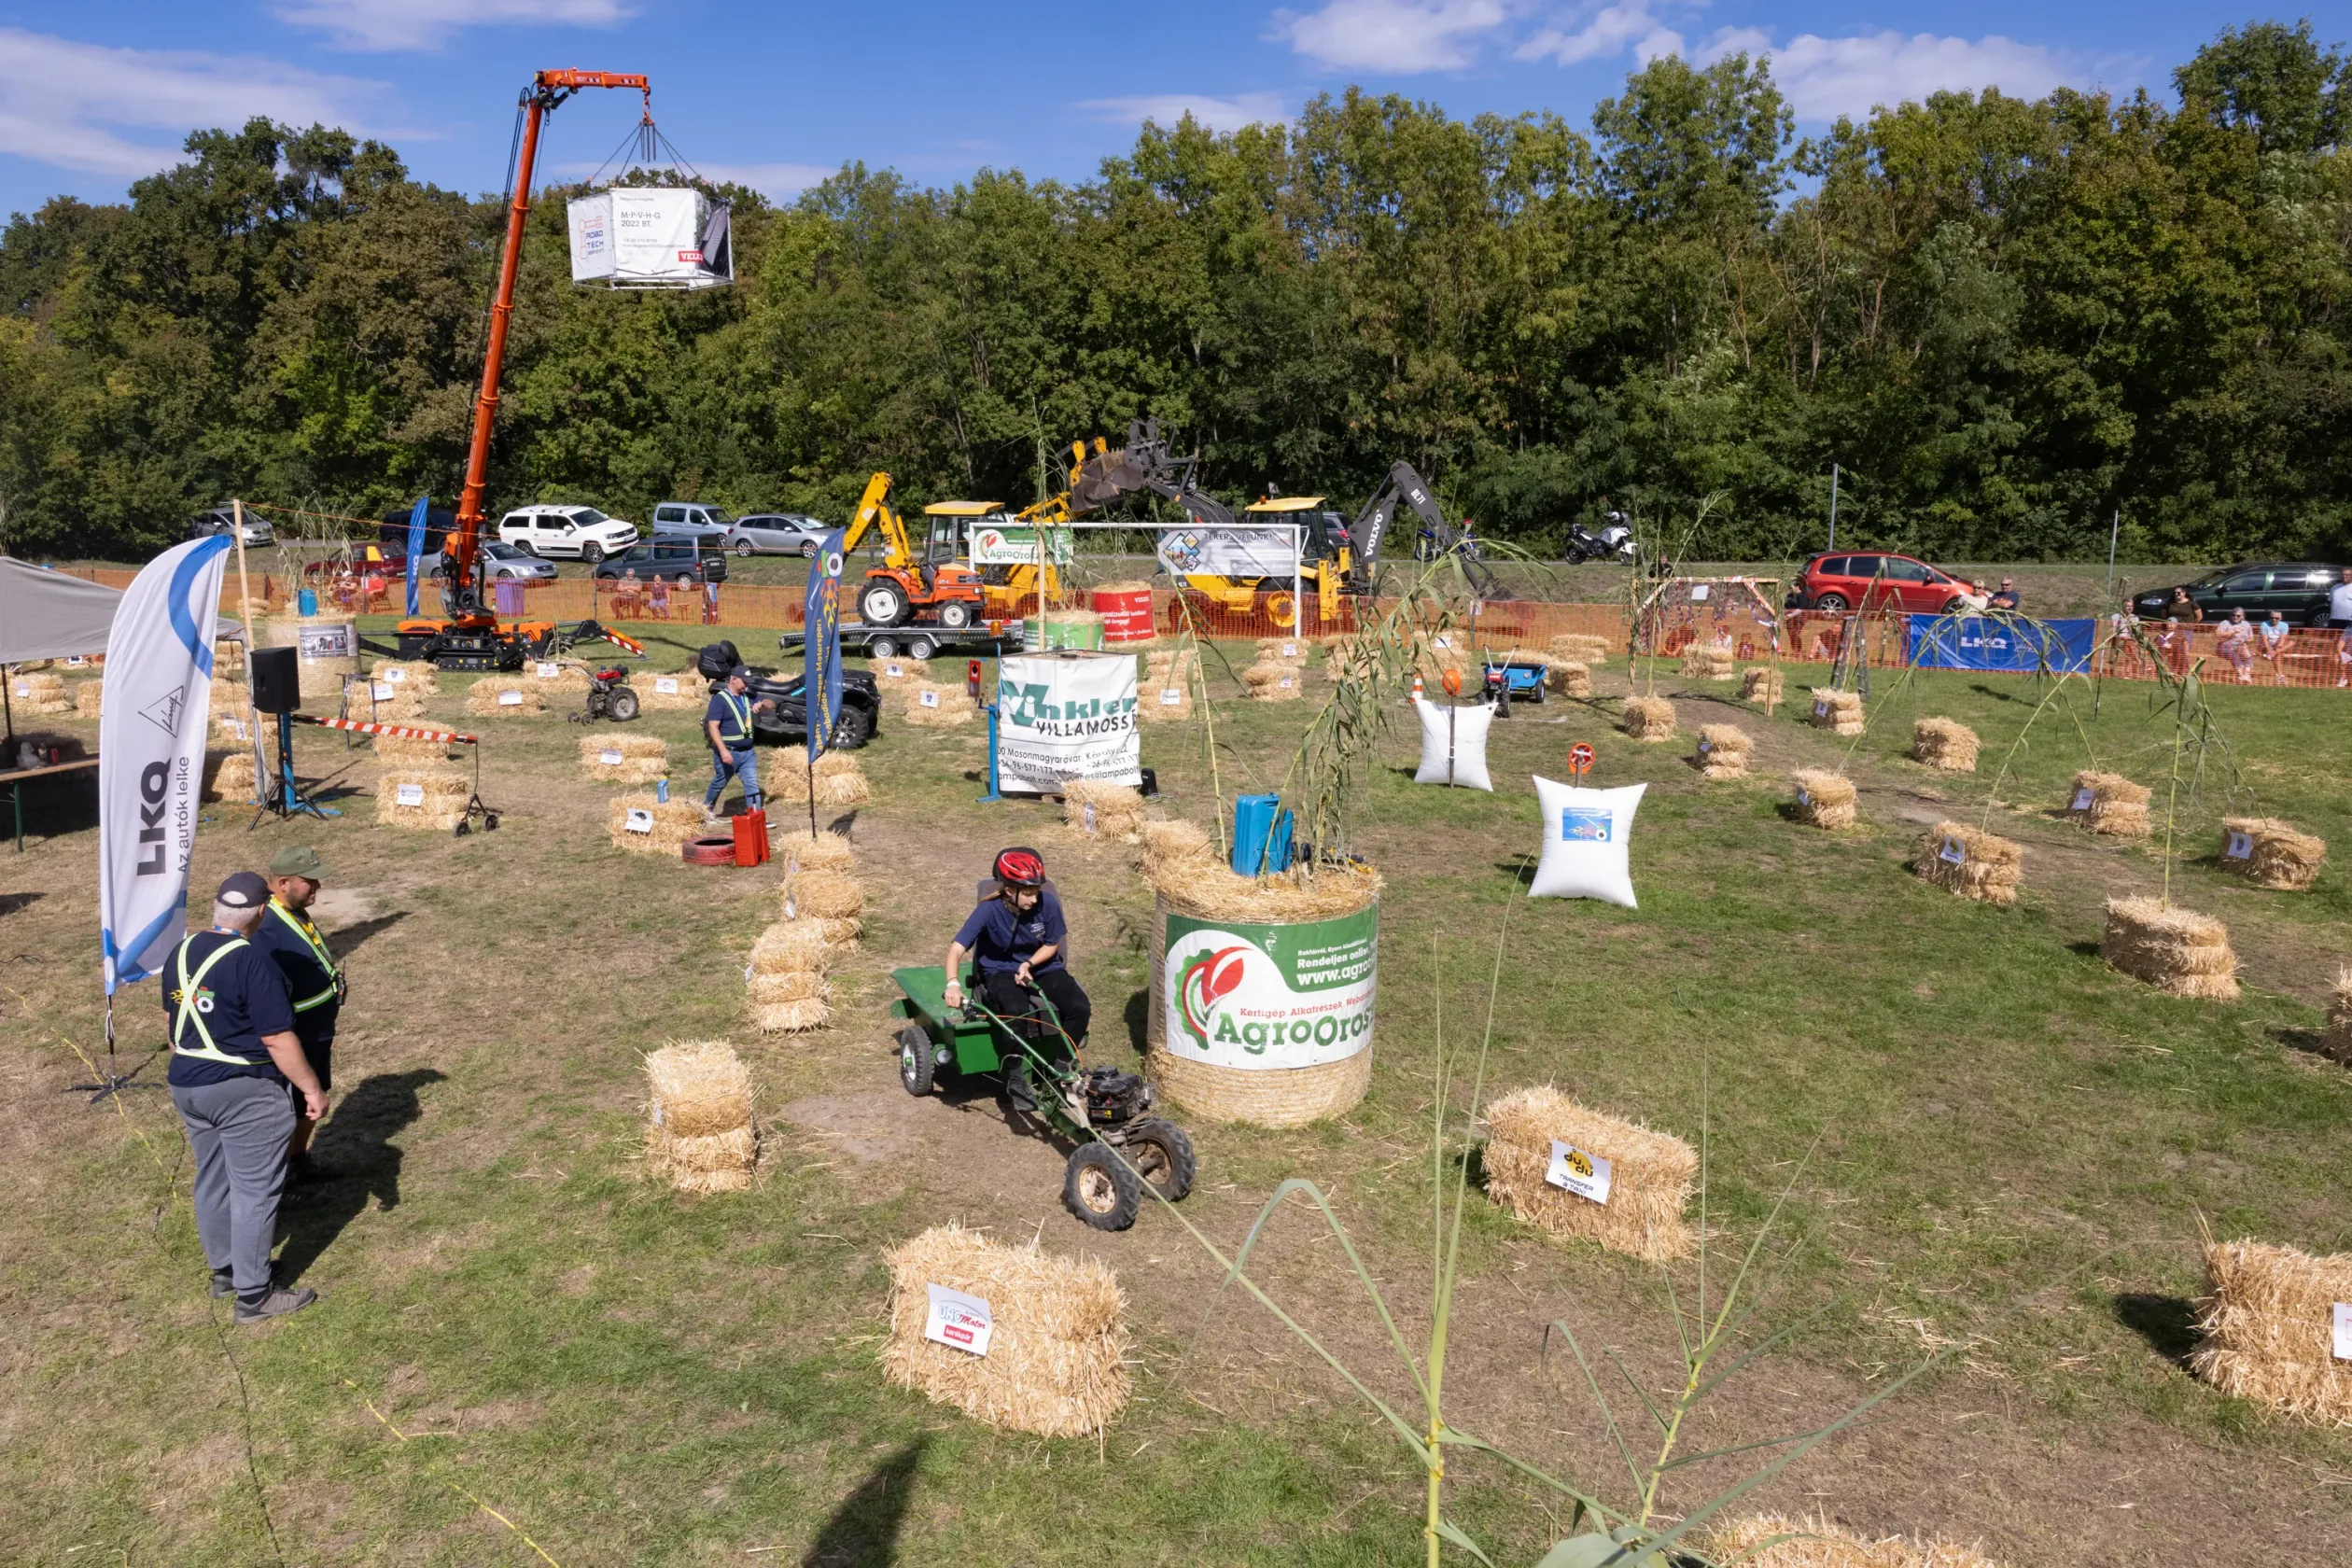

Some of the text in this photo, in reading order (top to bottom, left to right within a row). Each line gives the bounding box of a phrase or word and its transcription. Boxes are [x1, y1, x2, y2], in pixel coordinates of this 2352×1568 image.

[587, 240, 604, 248] TECH
[1410, 488, 1426, 504] BL71
[1365, 513, 1383, 557] VOLVO
[1960, 637, 2007, 650] LKQ
[136, 756, 172, 877] LKQ
[175, 756, 190, 874] Az autók lelke
[1297, 954, 1348, 969] Rendeljen
[1239, 1008, 1286, 1018] Kertigép
[1290, 1001, 1342, 1016] Alkatrészek
[1560, 1173, 1594, 1191] TRANSFER
[1570, 1184, 1587, 1194] TAXI
